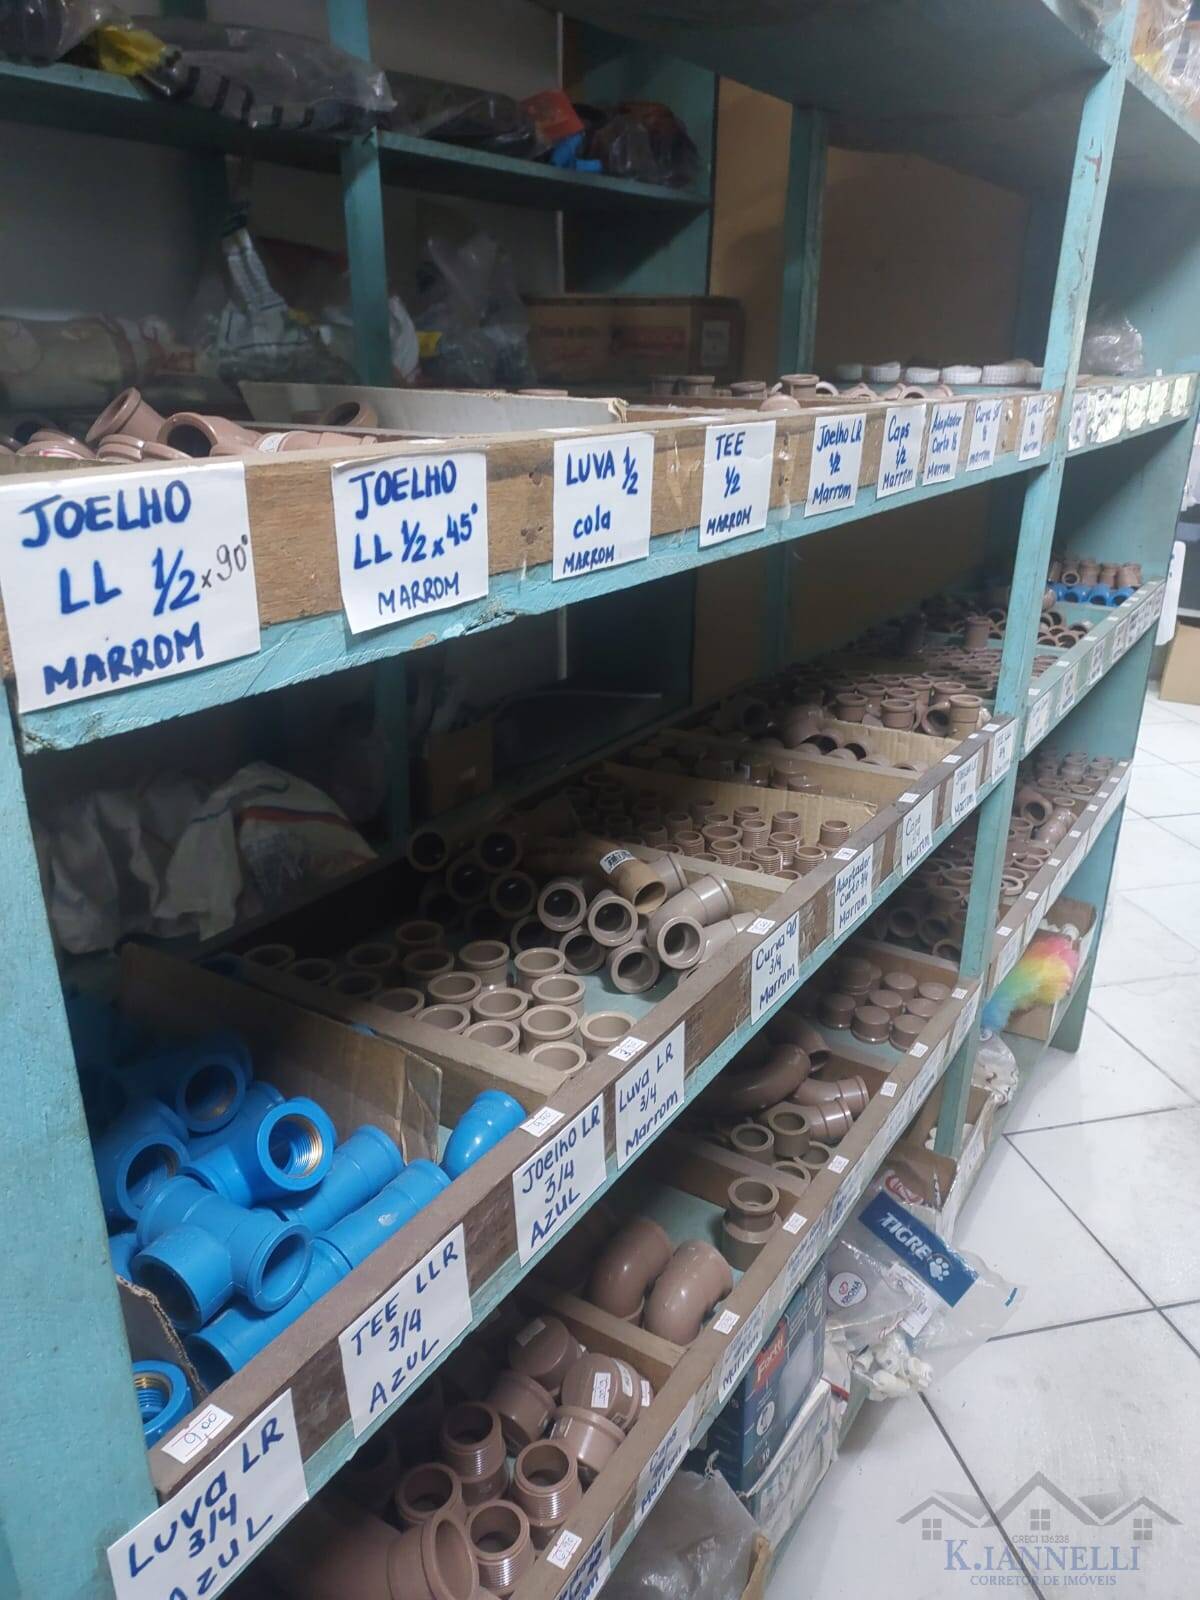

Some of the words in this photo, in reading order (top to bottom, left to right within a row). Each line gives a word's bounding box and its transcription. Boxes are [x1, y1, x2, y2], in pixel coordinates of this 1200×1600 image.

[716, 431, 746, 460] TEE
[816, 423, 849, 453] Joelho
[850, 419, 862, 444] LR
[888, 415, 911, 446] Caps
[566, 449, 616, 486] LUVA
[882, 468, 914, 490] Marrom
[349, 459, 458, 520] JOELHO
[812, 483, 851, 505] Marrom
[19, 480, 192, 548] JOELHO
[573, 504, 612, 539] cola
[706, 505, 752, 536] MARROM
[353, 533, 392, 570] LL
[563, 545, 615, 574] MARROM
[59, 559, 122, 615] LL
[378, 572, 460, 615] MARROM
[43, 621, 204, 695] MARROM
[756, 938, 785, 970] Curva
[759, 963, 795, 1010] Marrom
[618, 1068, 650, 1113] Luva
[656, 1041, 674, 1074] LR
[639, 1083, 657, 1112] 3/4
[582, 1104, 600, 1139] LR
[544, 1159, 575, 1203] 3/4
[879, 1211, 932, 1261] TIGRE
[351, 1292, 399, 1356] TEE
[416, 1240, 458, 1294] LLR
[388, 1308, 421, 1351] 3/4
[242, 1416, 285, 1473] LR
[189, 1492, 237, 1558] 3/4
